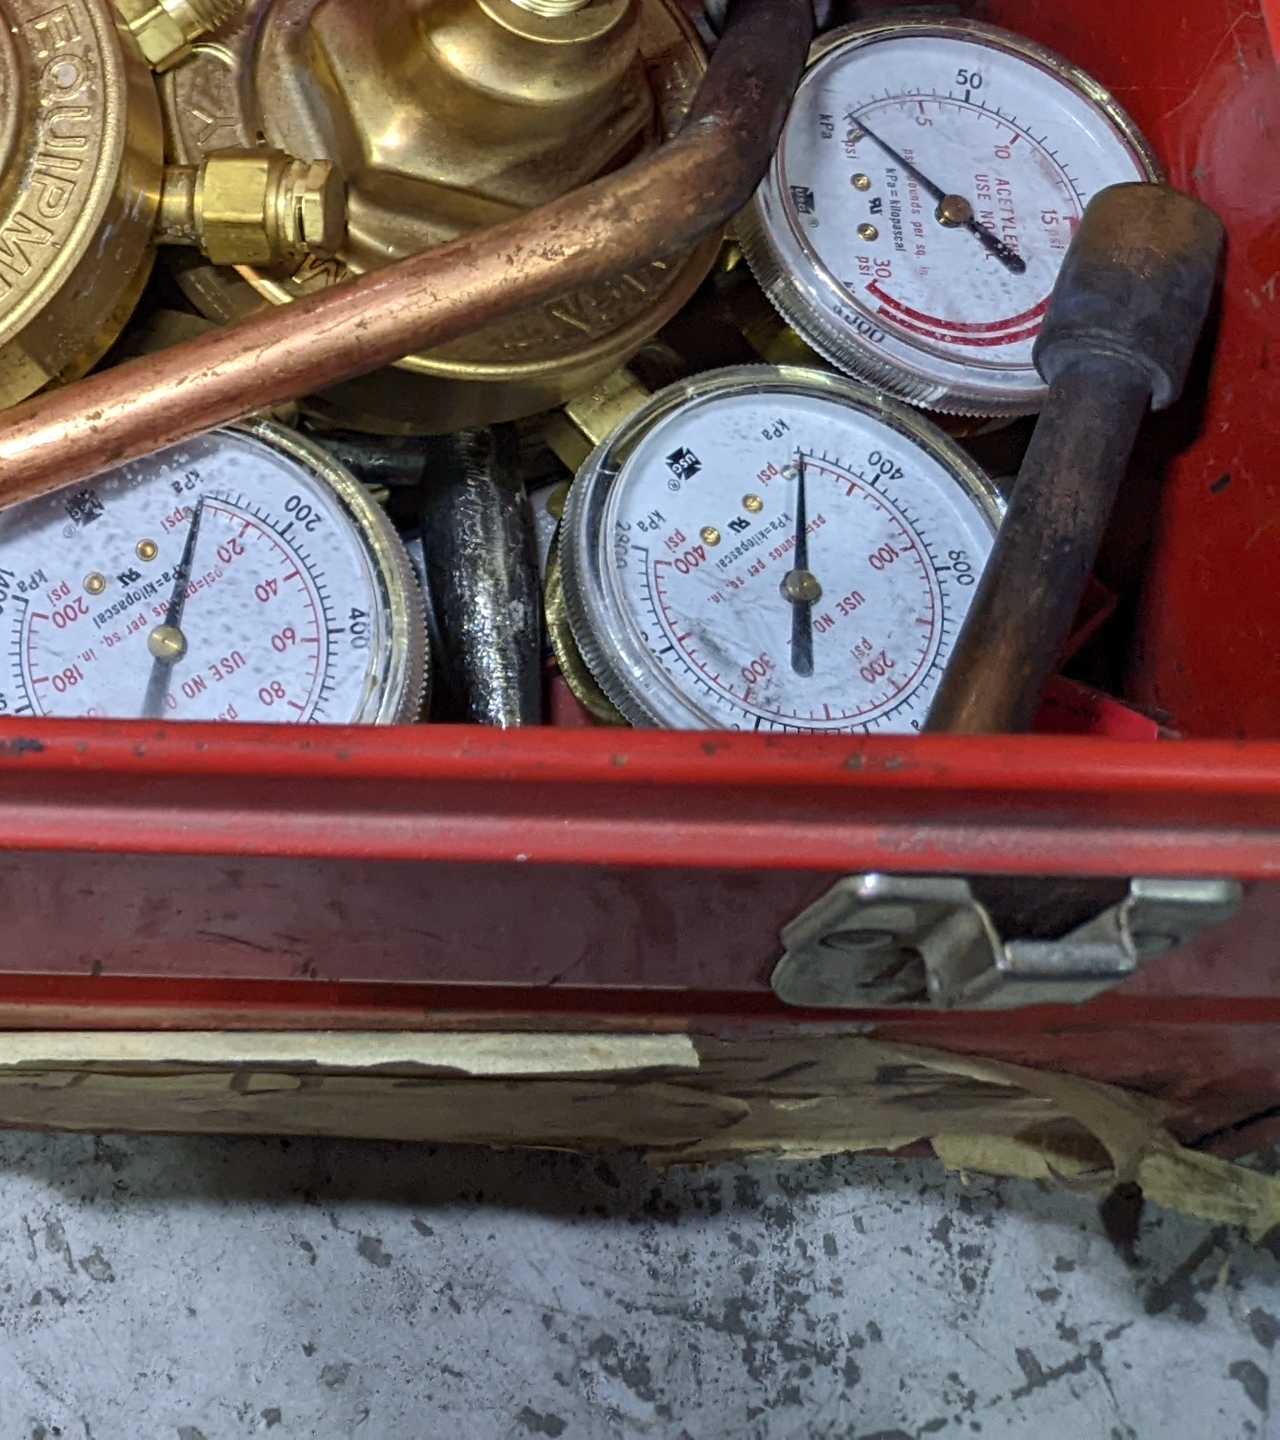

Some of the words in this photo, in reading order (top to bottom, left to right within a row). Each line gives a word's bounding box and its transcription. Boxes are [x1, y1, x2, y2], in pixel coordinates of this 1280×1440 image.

[955, 68, 984, 91] 50
[817, 113, 835, 140] kPa
[915, 117, 934, 128] 5
[993, 143, 1012, 161] 10
[974, 173, 991, 201] USE
[910, 220, 926, 240] per
[1040, 209, 1059, 226] 15
[854, 255, 874, 277] psi
[873, 258, 893, 280] 30
[761, 417, 791, 442] kPa
[756, 461, 781, 487] psi
[867, 450, 905, 482] 400
[170, 468, 205, 495] kPa
[159, 506, 187, 534] psi
[284, 495, 323, 533] 200
[636, 509, 667, 534] kPa
[215, 537, 247, 565] 20
[663, 527, 687, 554] psi
[674, 544, 709, 576] 400
[747, 558, 768, 578] per
[868, 543, 900, 572] 100
[948, 549, 976, 587] 800
[16, 568, 49, 594] kPa
[46, 580, 72, 608] psi
[254, 576, 279, 604] 40
[52, 595, 89, 630] 200
[835, 590, 867, 617] USE
[126, 614, 148, 635] per
[347, 605, 372, 652] 400
[812, 612, 837, 634] NO
[271, 626, 298, 654] 60
[849, 636, 875, 665] psi
[51, 663, 85, 694] 180
[207, 649, 248, 682] USE
[741, 651, 778, 685] 300
[859, 649, 897, 685] 200
[181, 673, 207, 700] NO
[257, 680, 287, 708] 80
